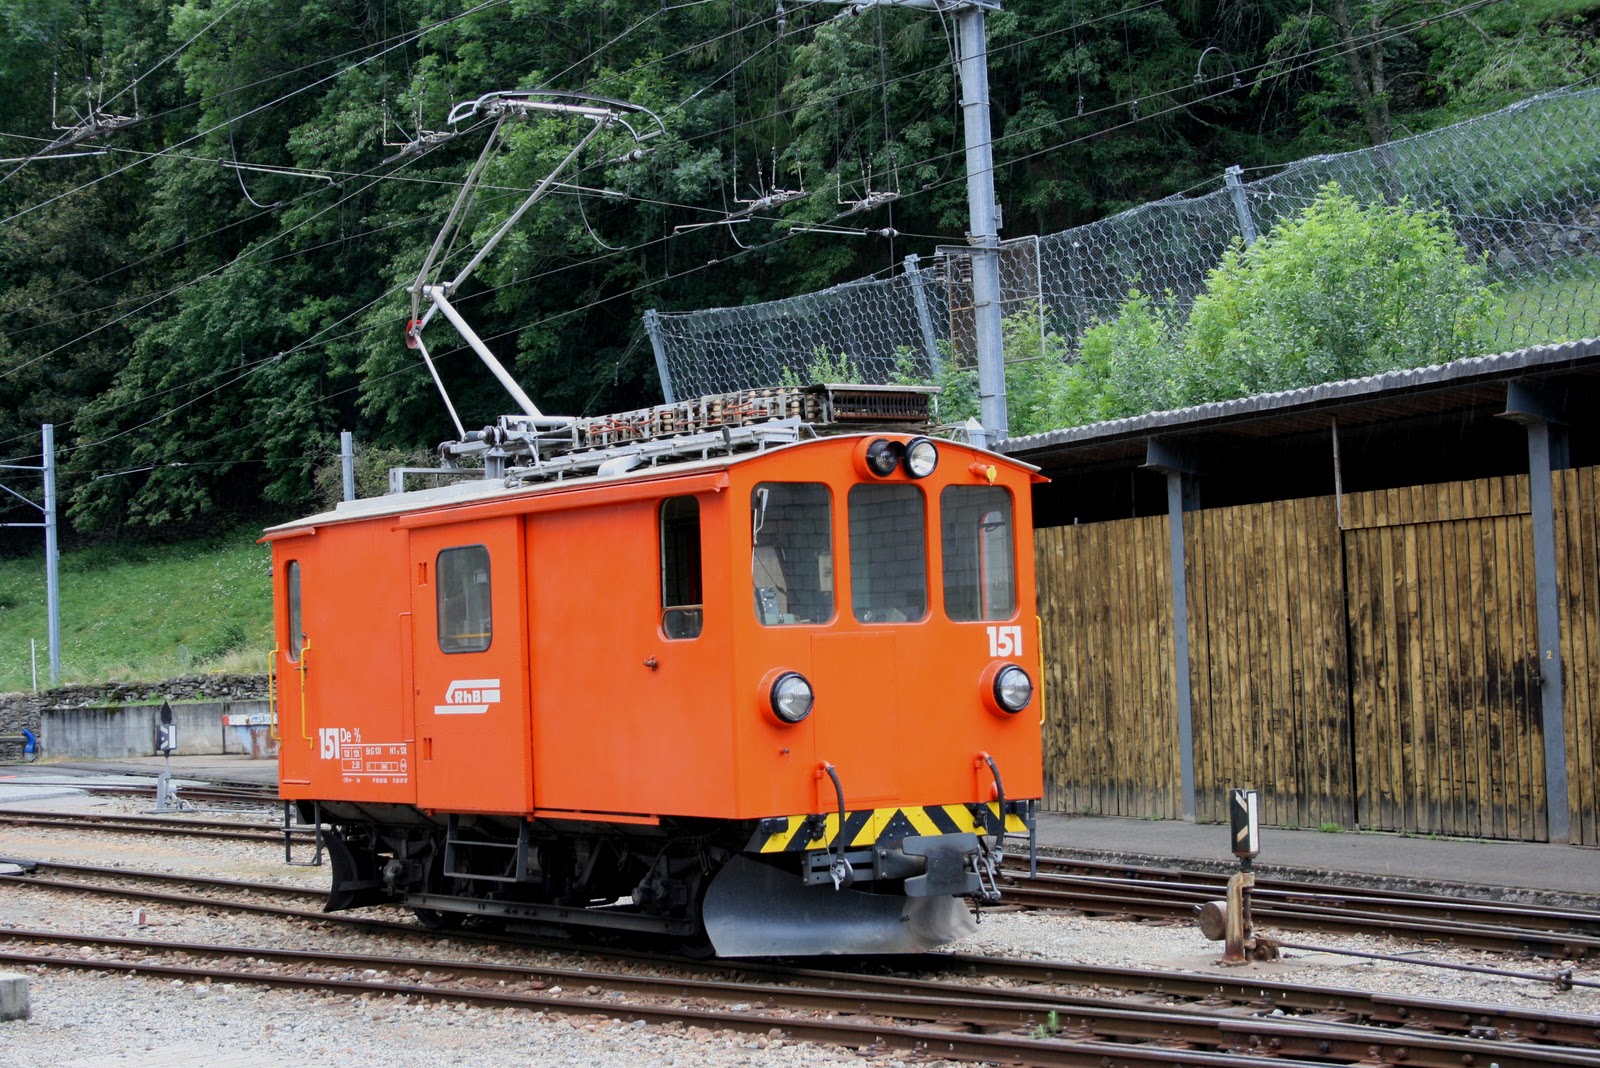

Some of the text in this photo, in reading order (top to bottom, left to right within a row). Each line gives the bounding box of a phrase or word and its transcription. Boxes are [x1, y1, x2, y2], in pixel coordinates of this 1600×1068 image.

[986, 625, 1022, 657] 151
[1546, 650, 1552, 660] 2
[454, 690, 482, 704] RhB
[318, 727, 340, 760] 151
[340, 727, 352, 743] De
